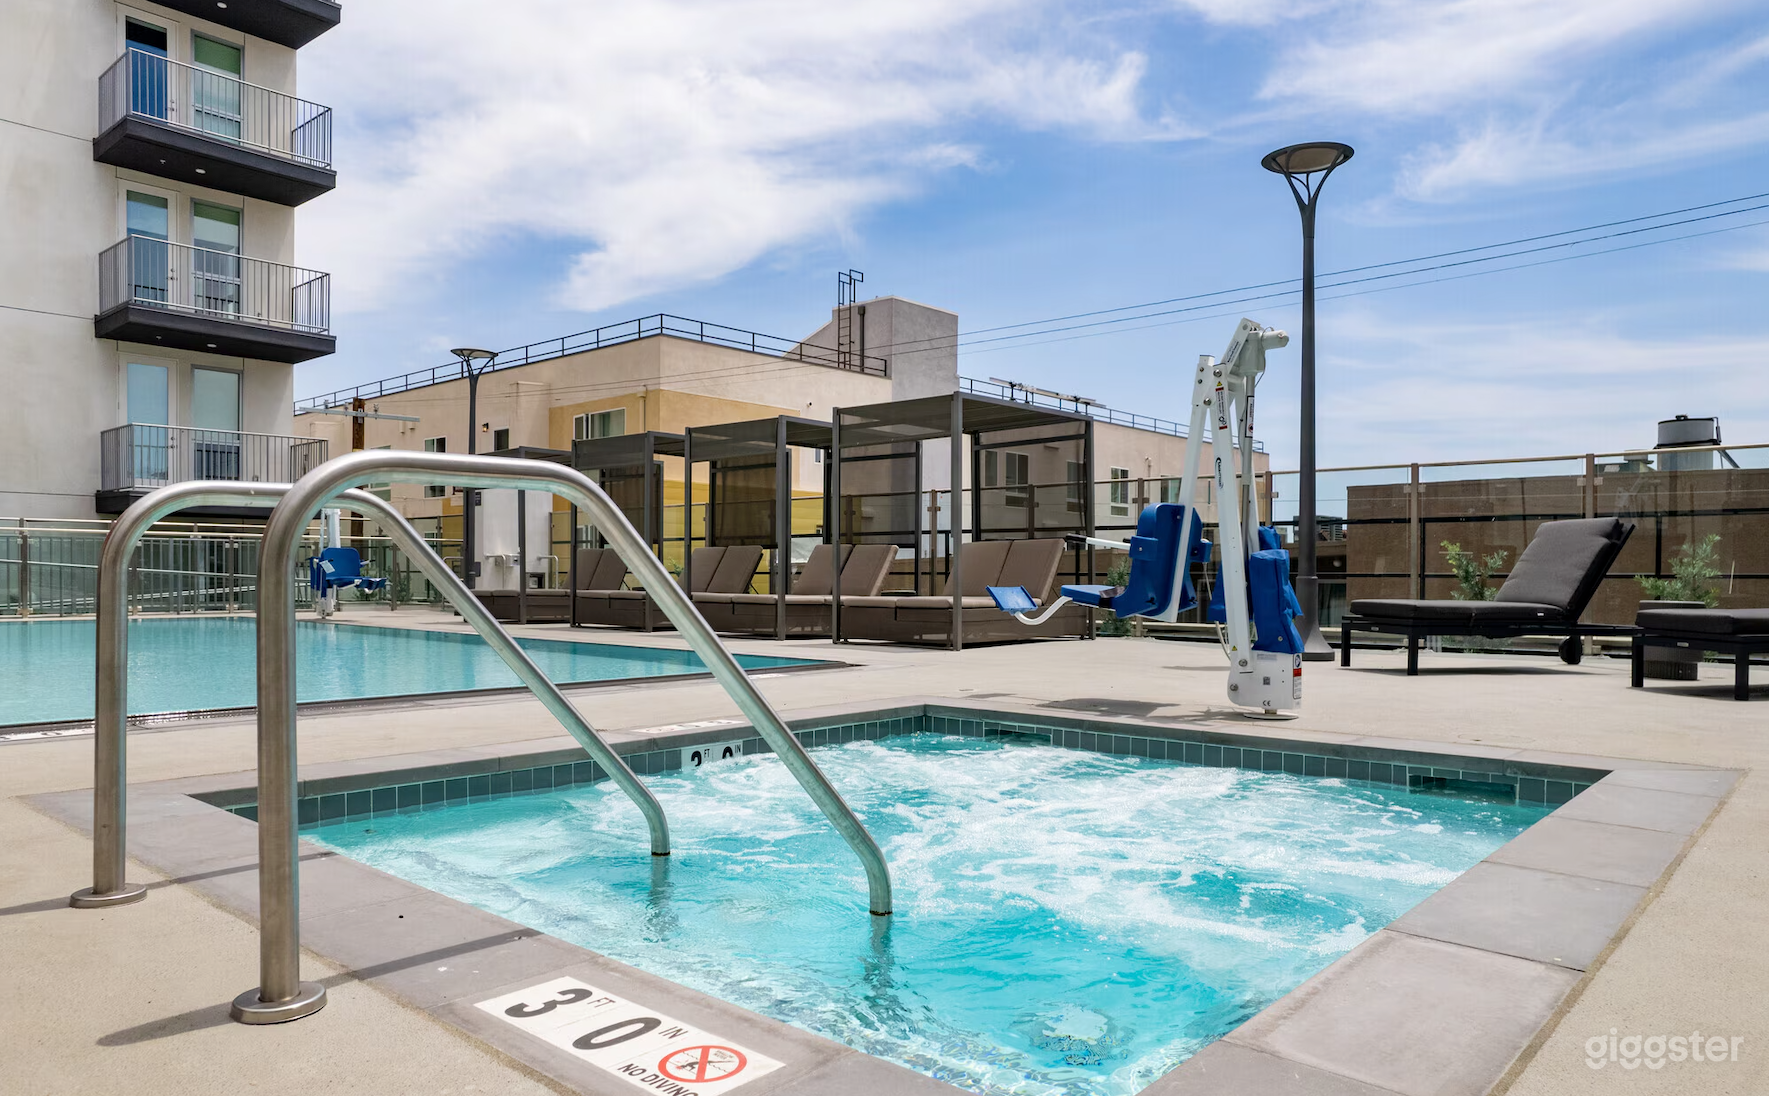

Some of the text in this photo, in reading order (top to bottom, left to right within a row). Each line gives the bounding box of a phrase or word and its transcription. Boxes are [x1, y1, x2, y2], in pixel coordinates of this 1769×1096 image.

[735, 744, 741, 753] IN
[504, 988, 616, 1018] 3 FT
[572, 1017, 688, 1050] 0 IN
[617, 1063, 647, 1077] NO
